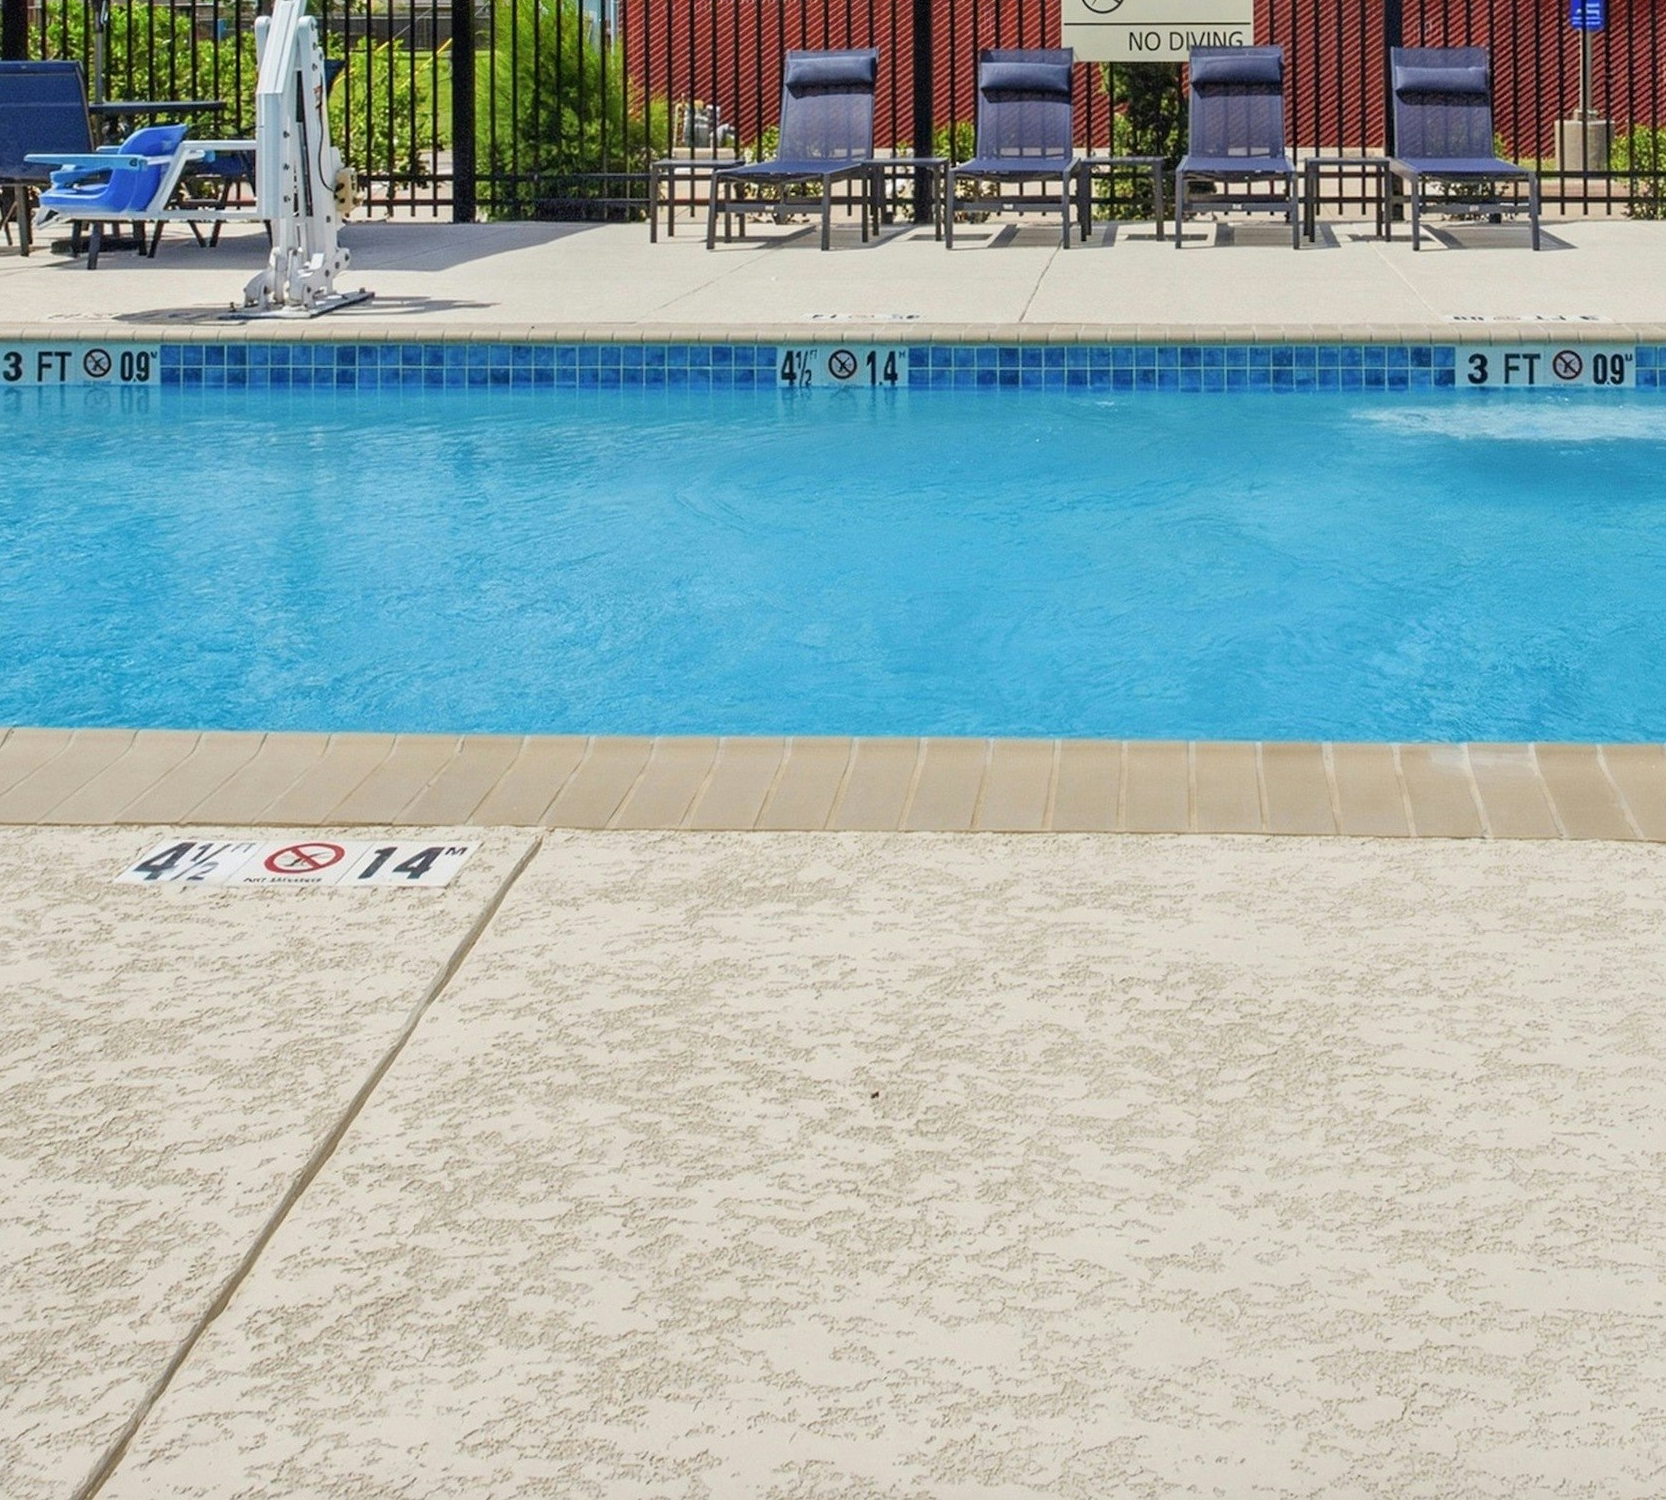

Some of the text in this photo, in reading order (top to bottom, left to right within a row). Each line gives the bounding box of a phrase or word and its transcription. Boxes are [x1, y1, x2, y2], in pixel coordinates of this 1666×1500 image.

[1129, 31, 1243, 51] NO DIVING
[3, 351, 23, 382] 3
[37, 351, 72, 382] FT
[1468, 353, 1489, 385] 3
[1504, 353, 1541, 385] FT
